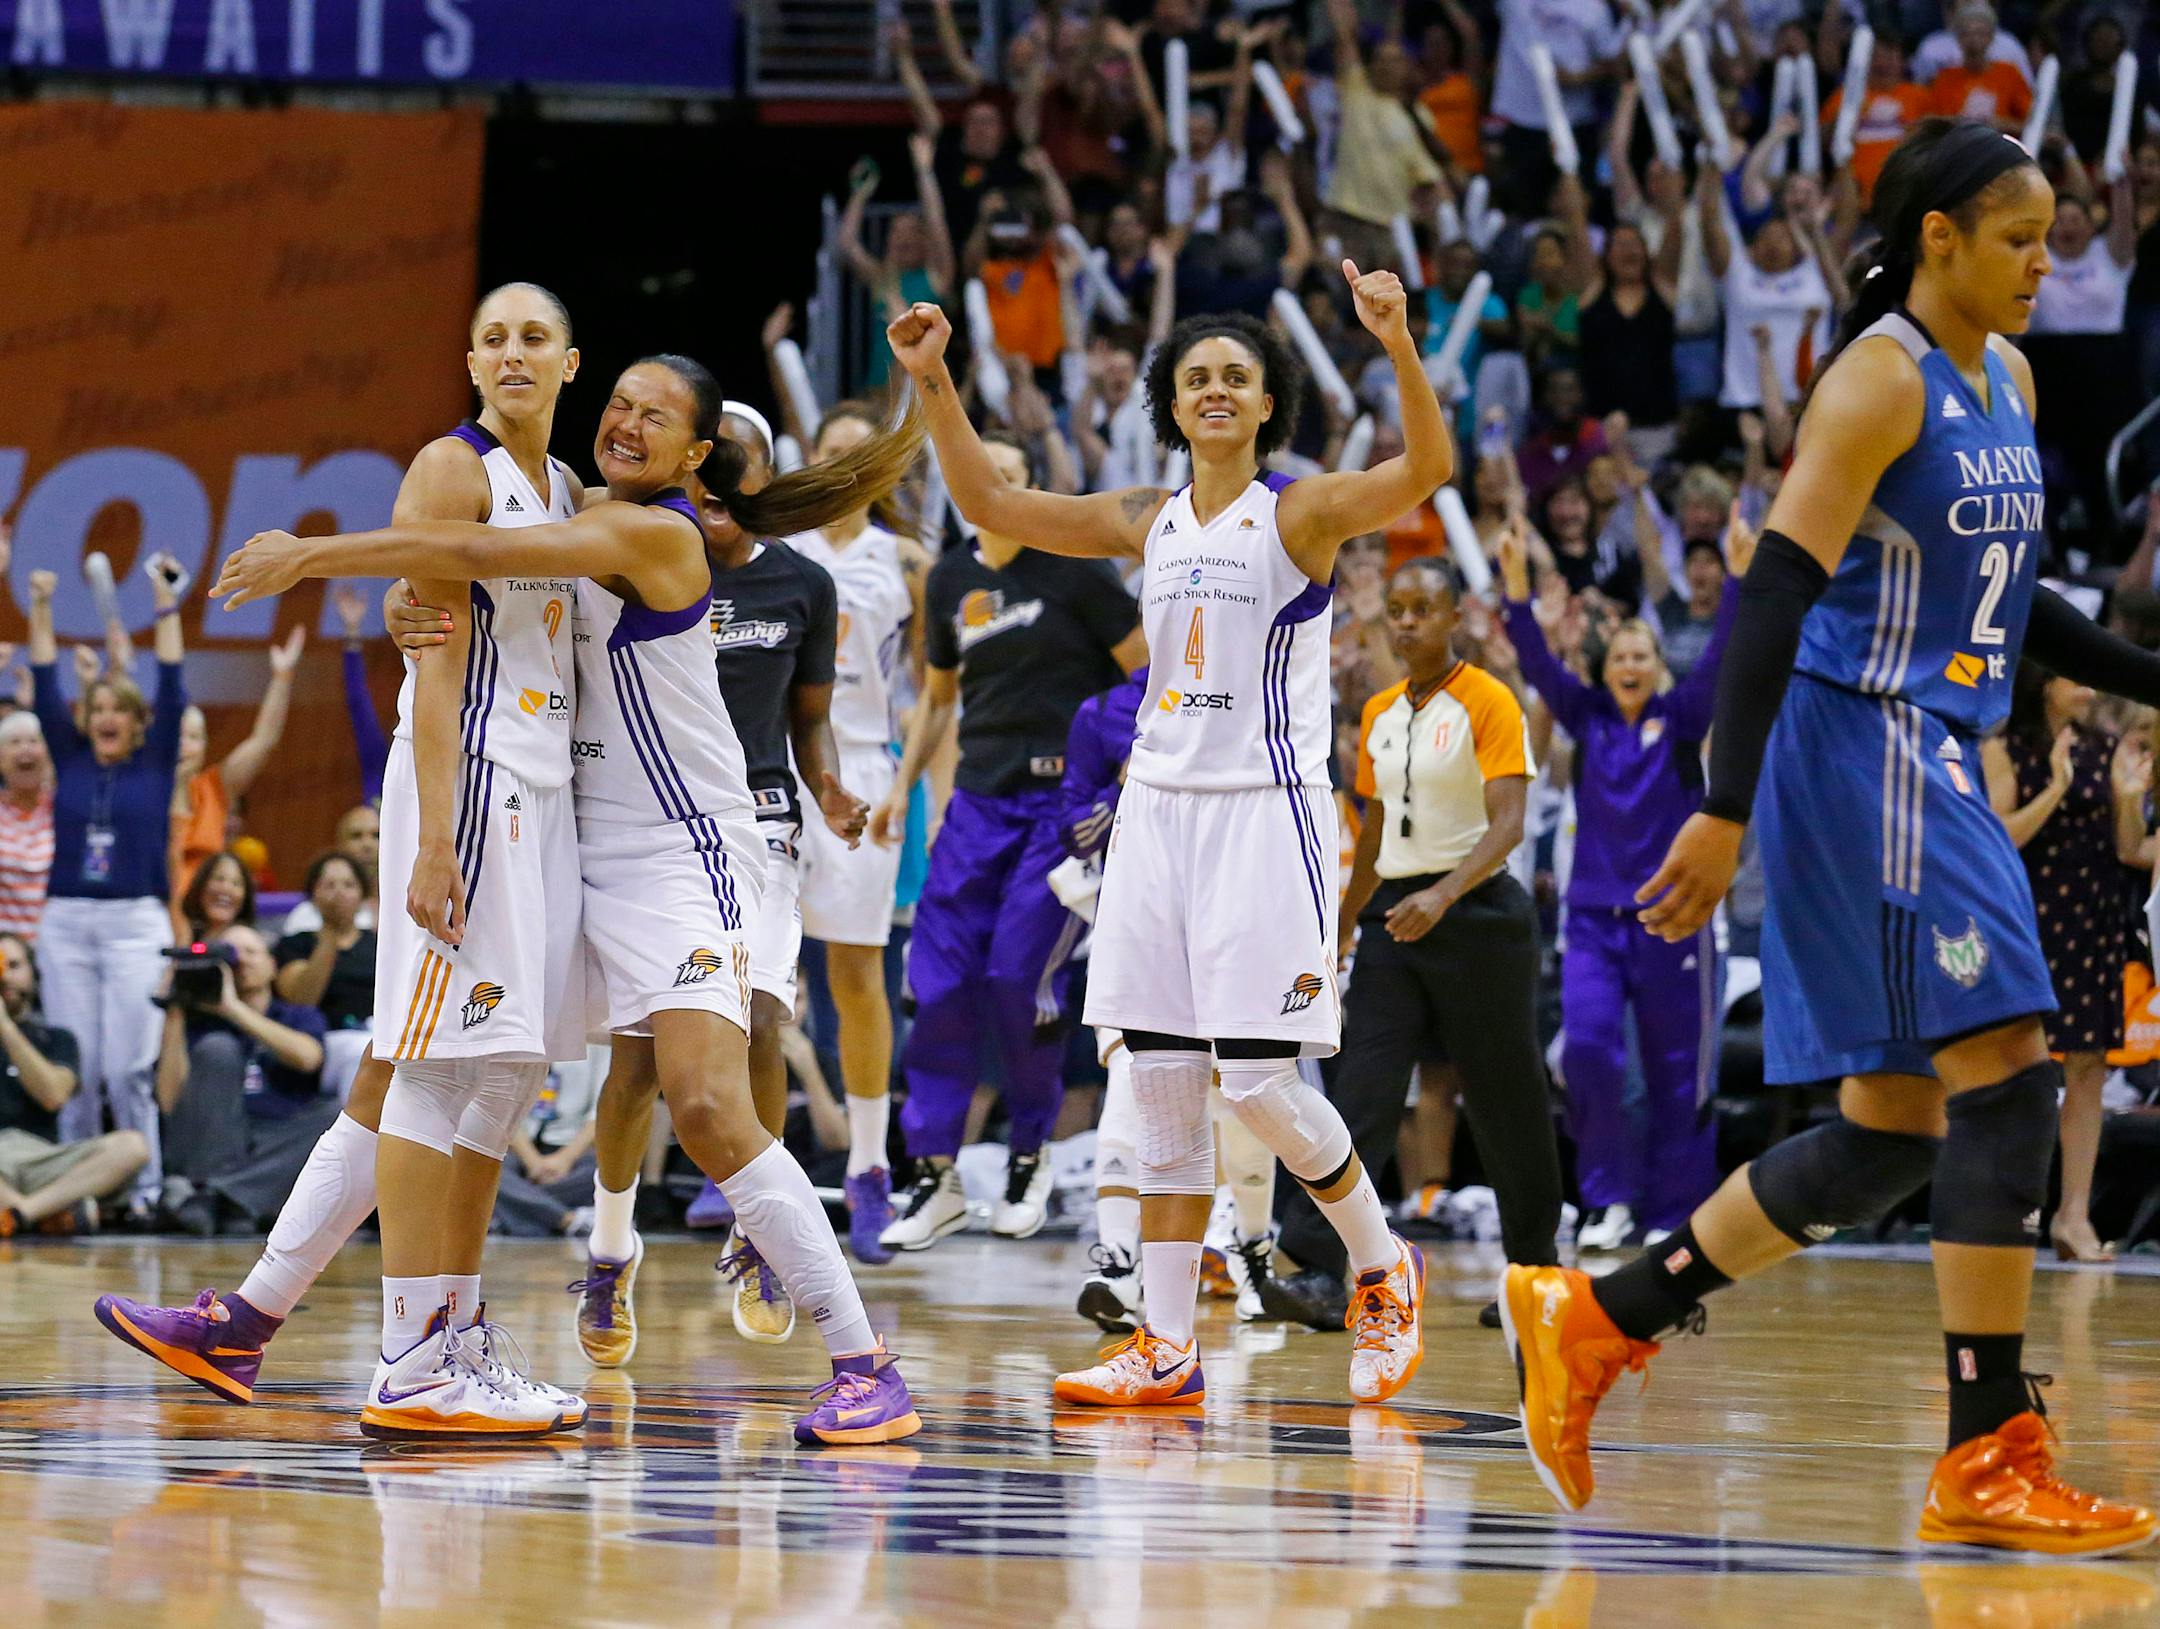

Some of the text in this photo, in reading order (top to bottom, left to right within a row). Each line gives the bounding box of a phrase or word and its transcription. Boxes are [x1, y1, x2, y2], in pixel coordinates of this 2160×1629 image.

[1952, 446, 2042, 488] MAYO
[1213, 588, 1258, 605] RESORT
[1184, 606, 1204, 680] 4
